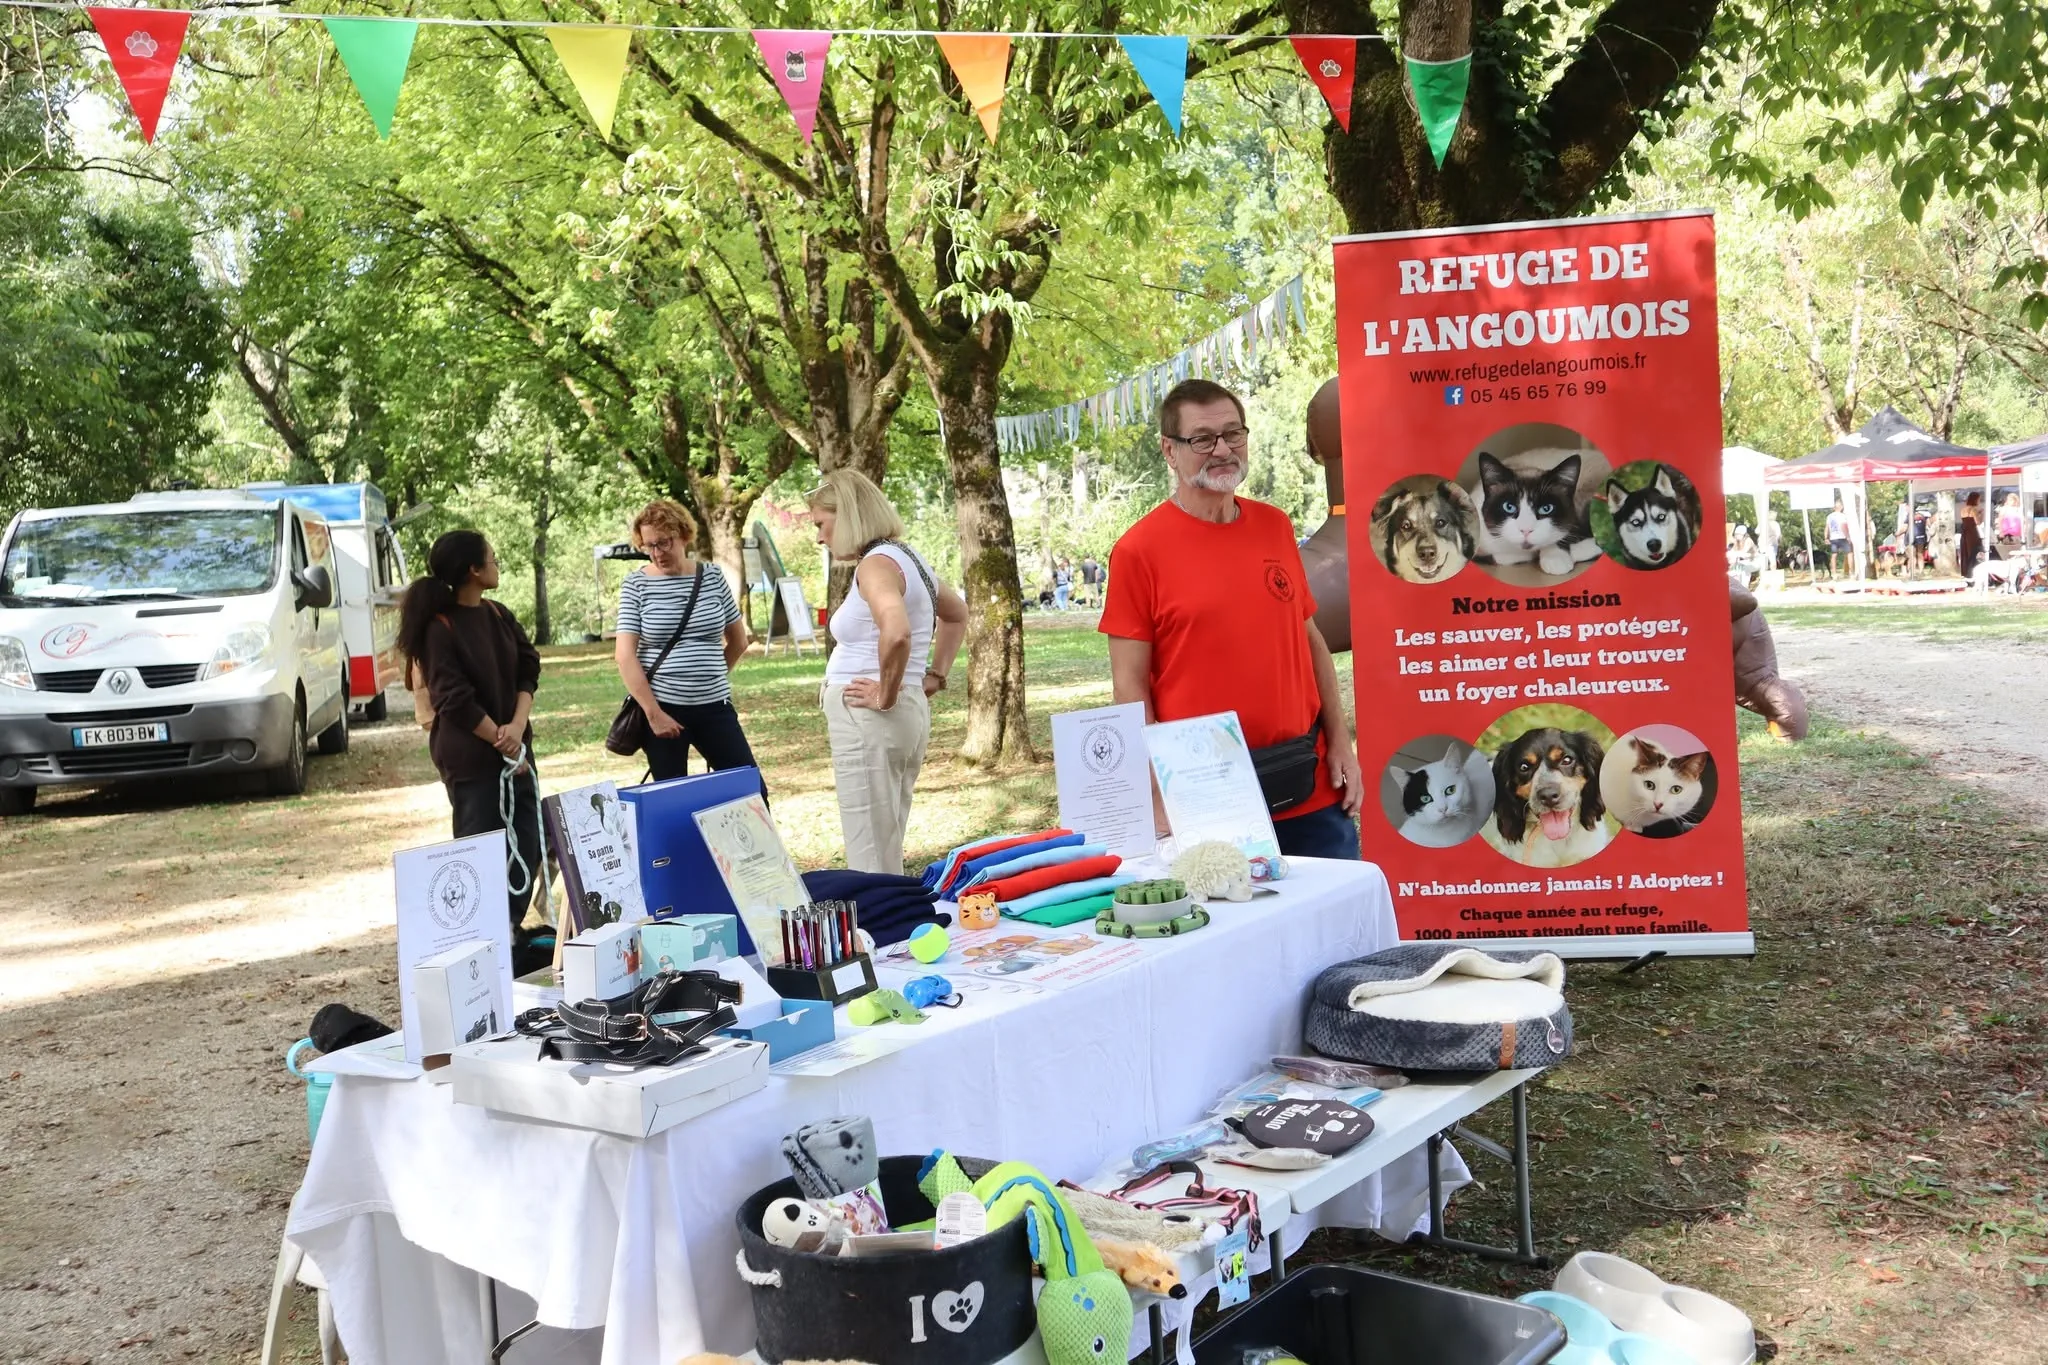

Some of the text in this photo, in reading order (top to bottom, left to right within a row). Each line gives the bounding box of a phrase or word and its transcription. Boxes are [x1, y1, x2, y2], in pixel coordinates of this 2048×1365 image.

[1399, 243, 1649, 294] REFUGE DE
[1363, 300, 1690, 356] L'ANGOUMOIS
[1410, 352, 1646, 383] www.refugedelangoumois.fr
[1471, 388, 1493, 404] 05
[1499, 386, 1521, 402] 45
[1527, 385, 1549, 399] 65
[1555, 383, 1577, 397] 76
[1584, 381, 1606, 395] 99
[1452, 590, 1621, 614] Notre mission
[1395, 616, 1688, 646] Les sauver, les protéger,
[1399, 647, 1686, 675] les aimer et leur trouver
[1419, 677, 1669, 705] un foyer chaleureux.
[588, 849, 597, 859] Sa
[597, 845, 614, 858] patte
[1398, 871, 1723, 897] N'abandonnez jamais ! Adoptez !
[1460, 903, 1664, 923] Chaque année au refuge,
[1414, 920, 1713, 940] 1000 animaux attendent une famille.
[908, 1295, 927, 1344] I
